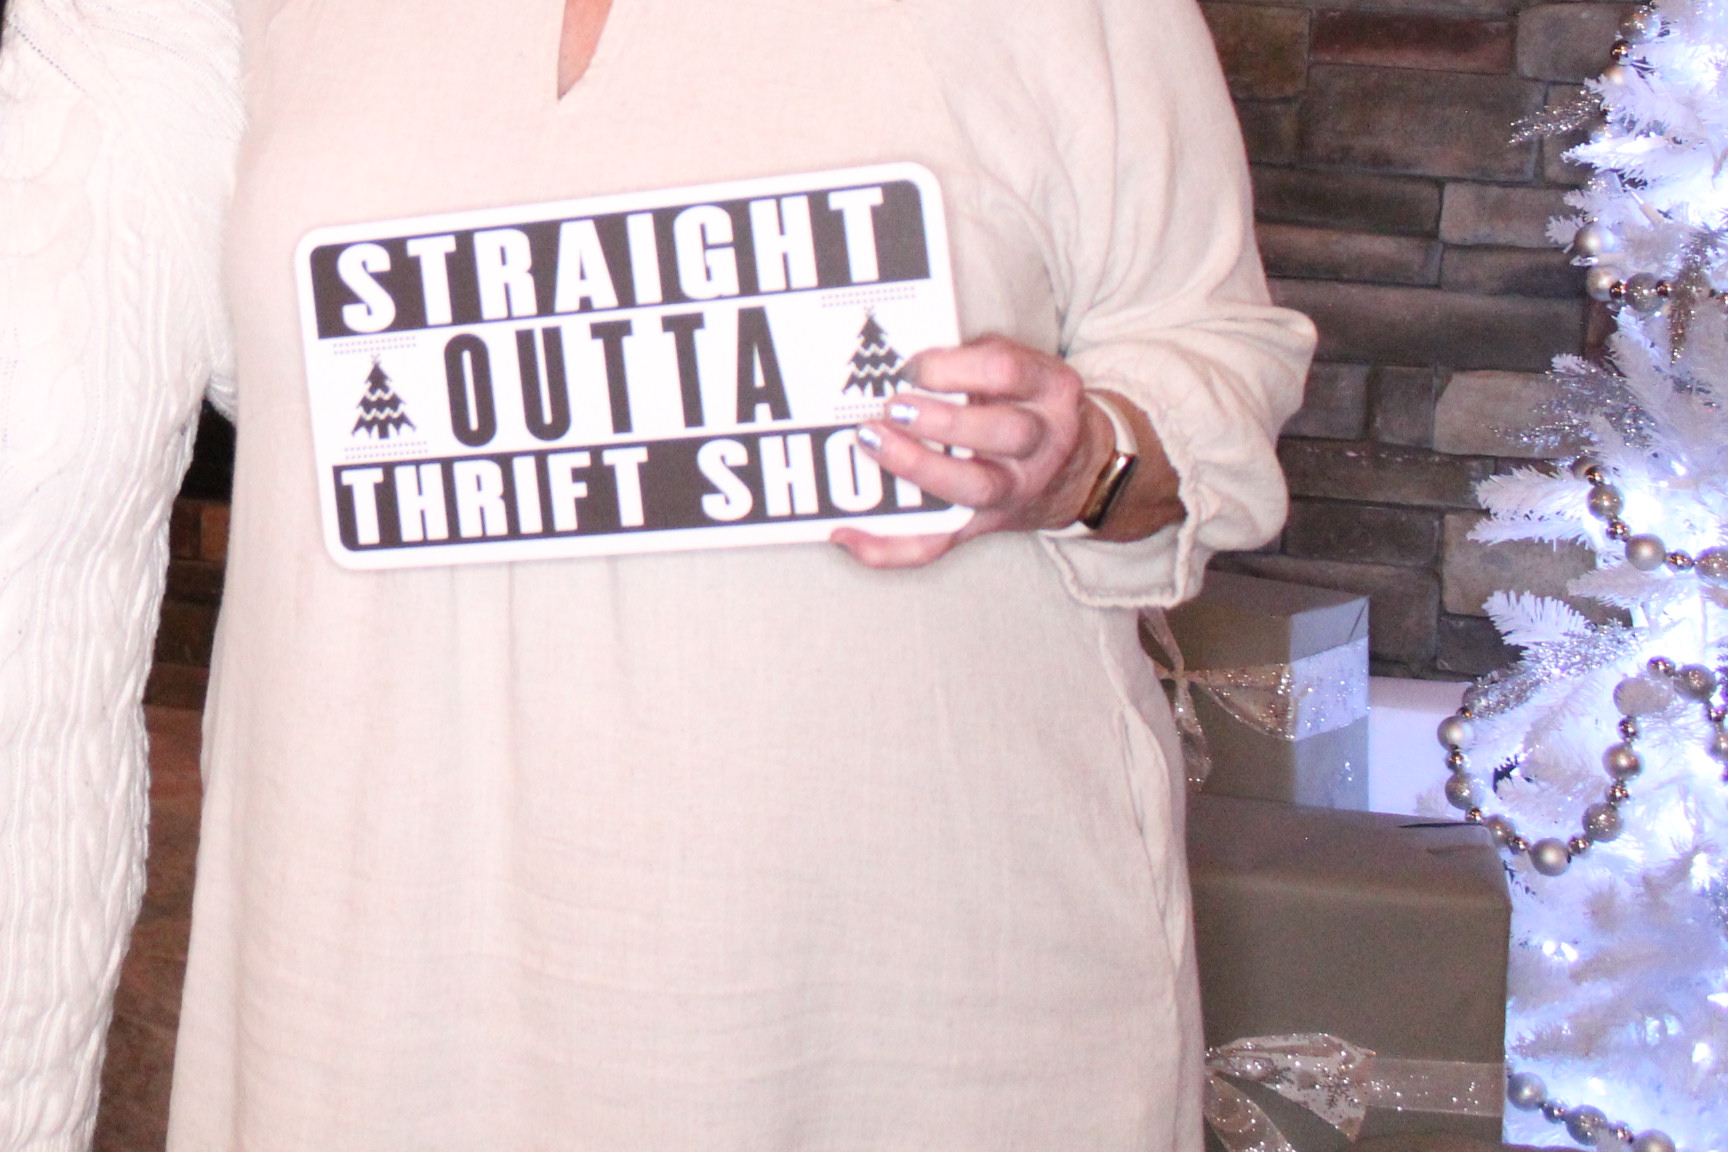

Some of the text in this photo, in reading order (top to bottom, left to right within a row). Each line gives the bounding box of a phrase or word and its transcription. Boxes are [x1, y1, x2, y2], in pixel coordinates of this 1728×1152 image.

[338, 187, 884, 334] STRAIGHT
[443, 306, 792, 448] OUTTA
[340, 446, 649, 545] THRIFT
